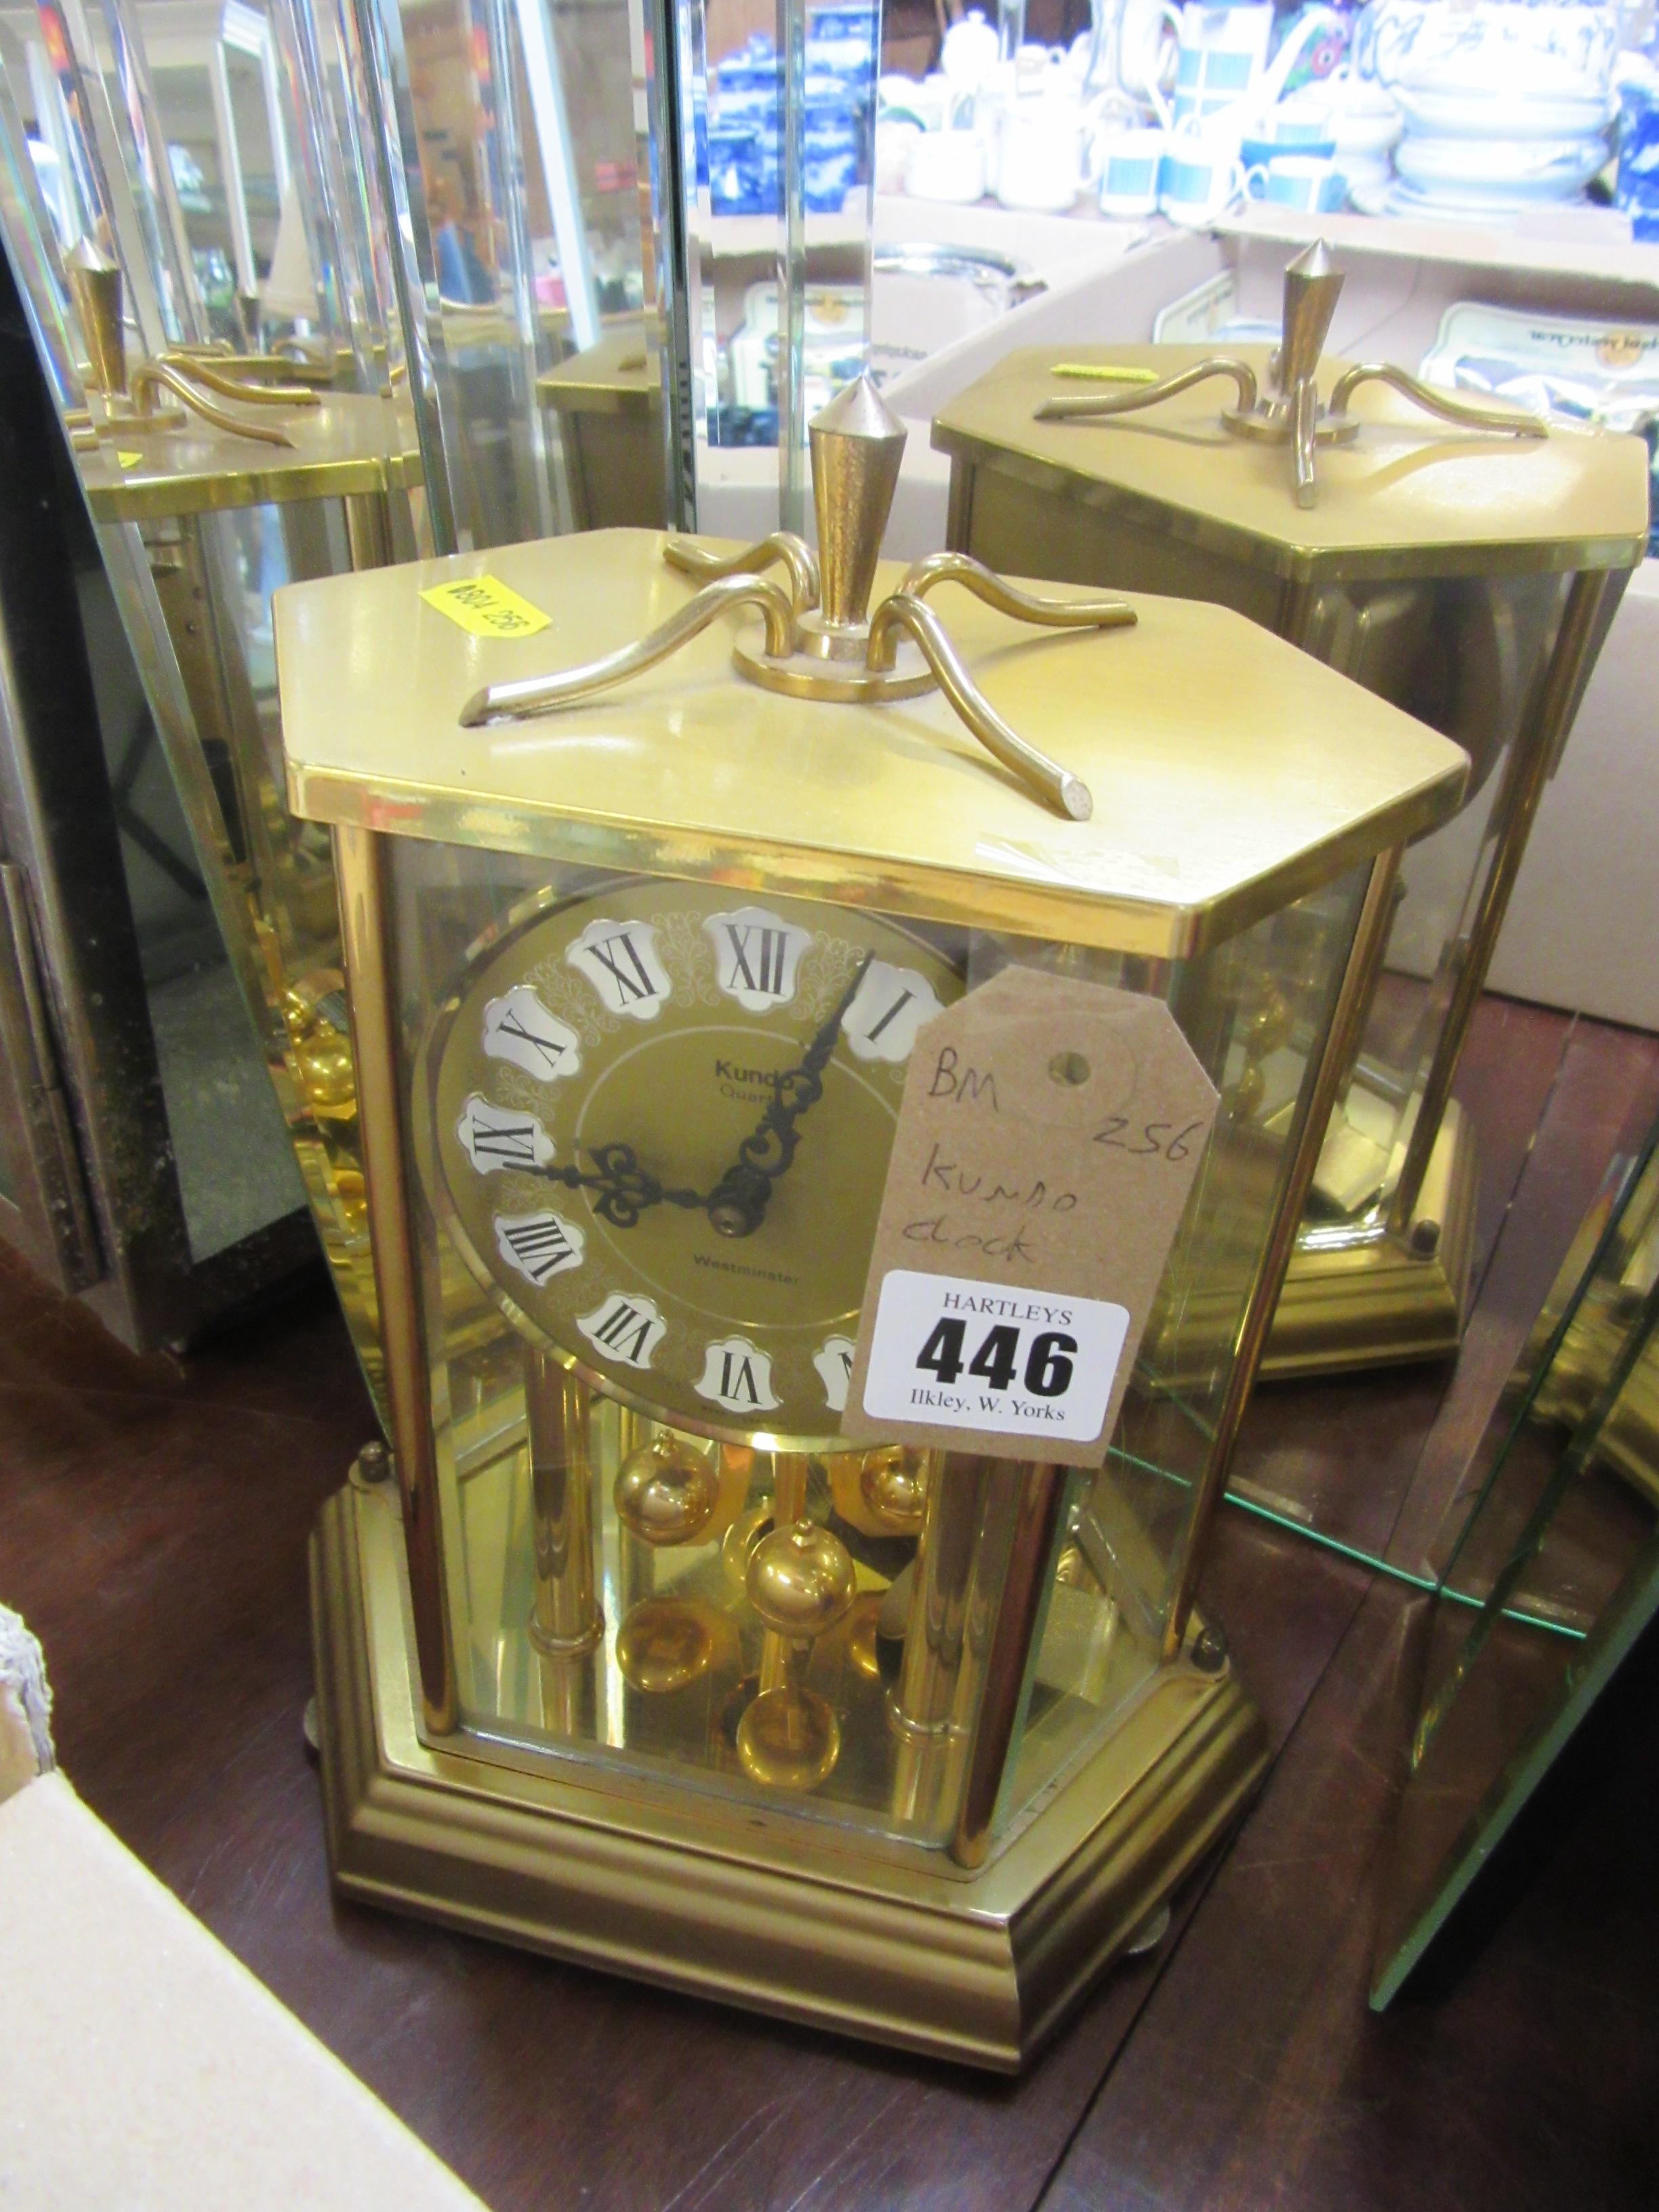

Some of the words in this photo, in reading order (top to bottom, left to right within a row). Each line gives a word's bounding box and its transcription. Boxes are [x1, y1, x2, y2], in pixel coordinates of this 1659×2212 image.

[584, 933, 659, 1006] XI
[726, 924, 792, 995] XII
[496, 1008, 566, 1068] X
[865, 987, 916, 1044] I
[928, 1047, 1000, 1112] BM
[472, 1115, 535, 1162] IX
[1092, 1117, 1204, 1162] 256
[501, 1218, 576, 1280] VIII
[694, 1253, 799, 1286] Westminster
[591, 1300, 655, 1363] VII
[943, 1291, 1073, 1326] HARTLEYS
[718, 1351, 764, 1405] VI
[915, 1317, 1079, 1398] 446
[910, 1388, 972, 1413] Ilkley,
[979, 1395, 1003, 1414] W.
[1010, 1400, 1066, 1422] Yorks
